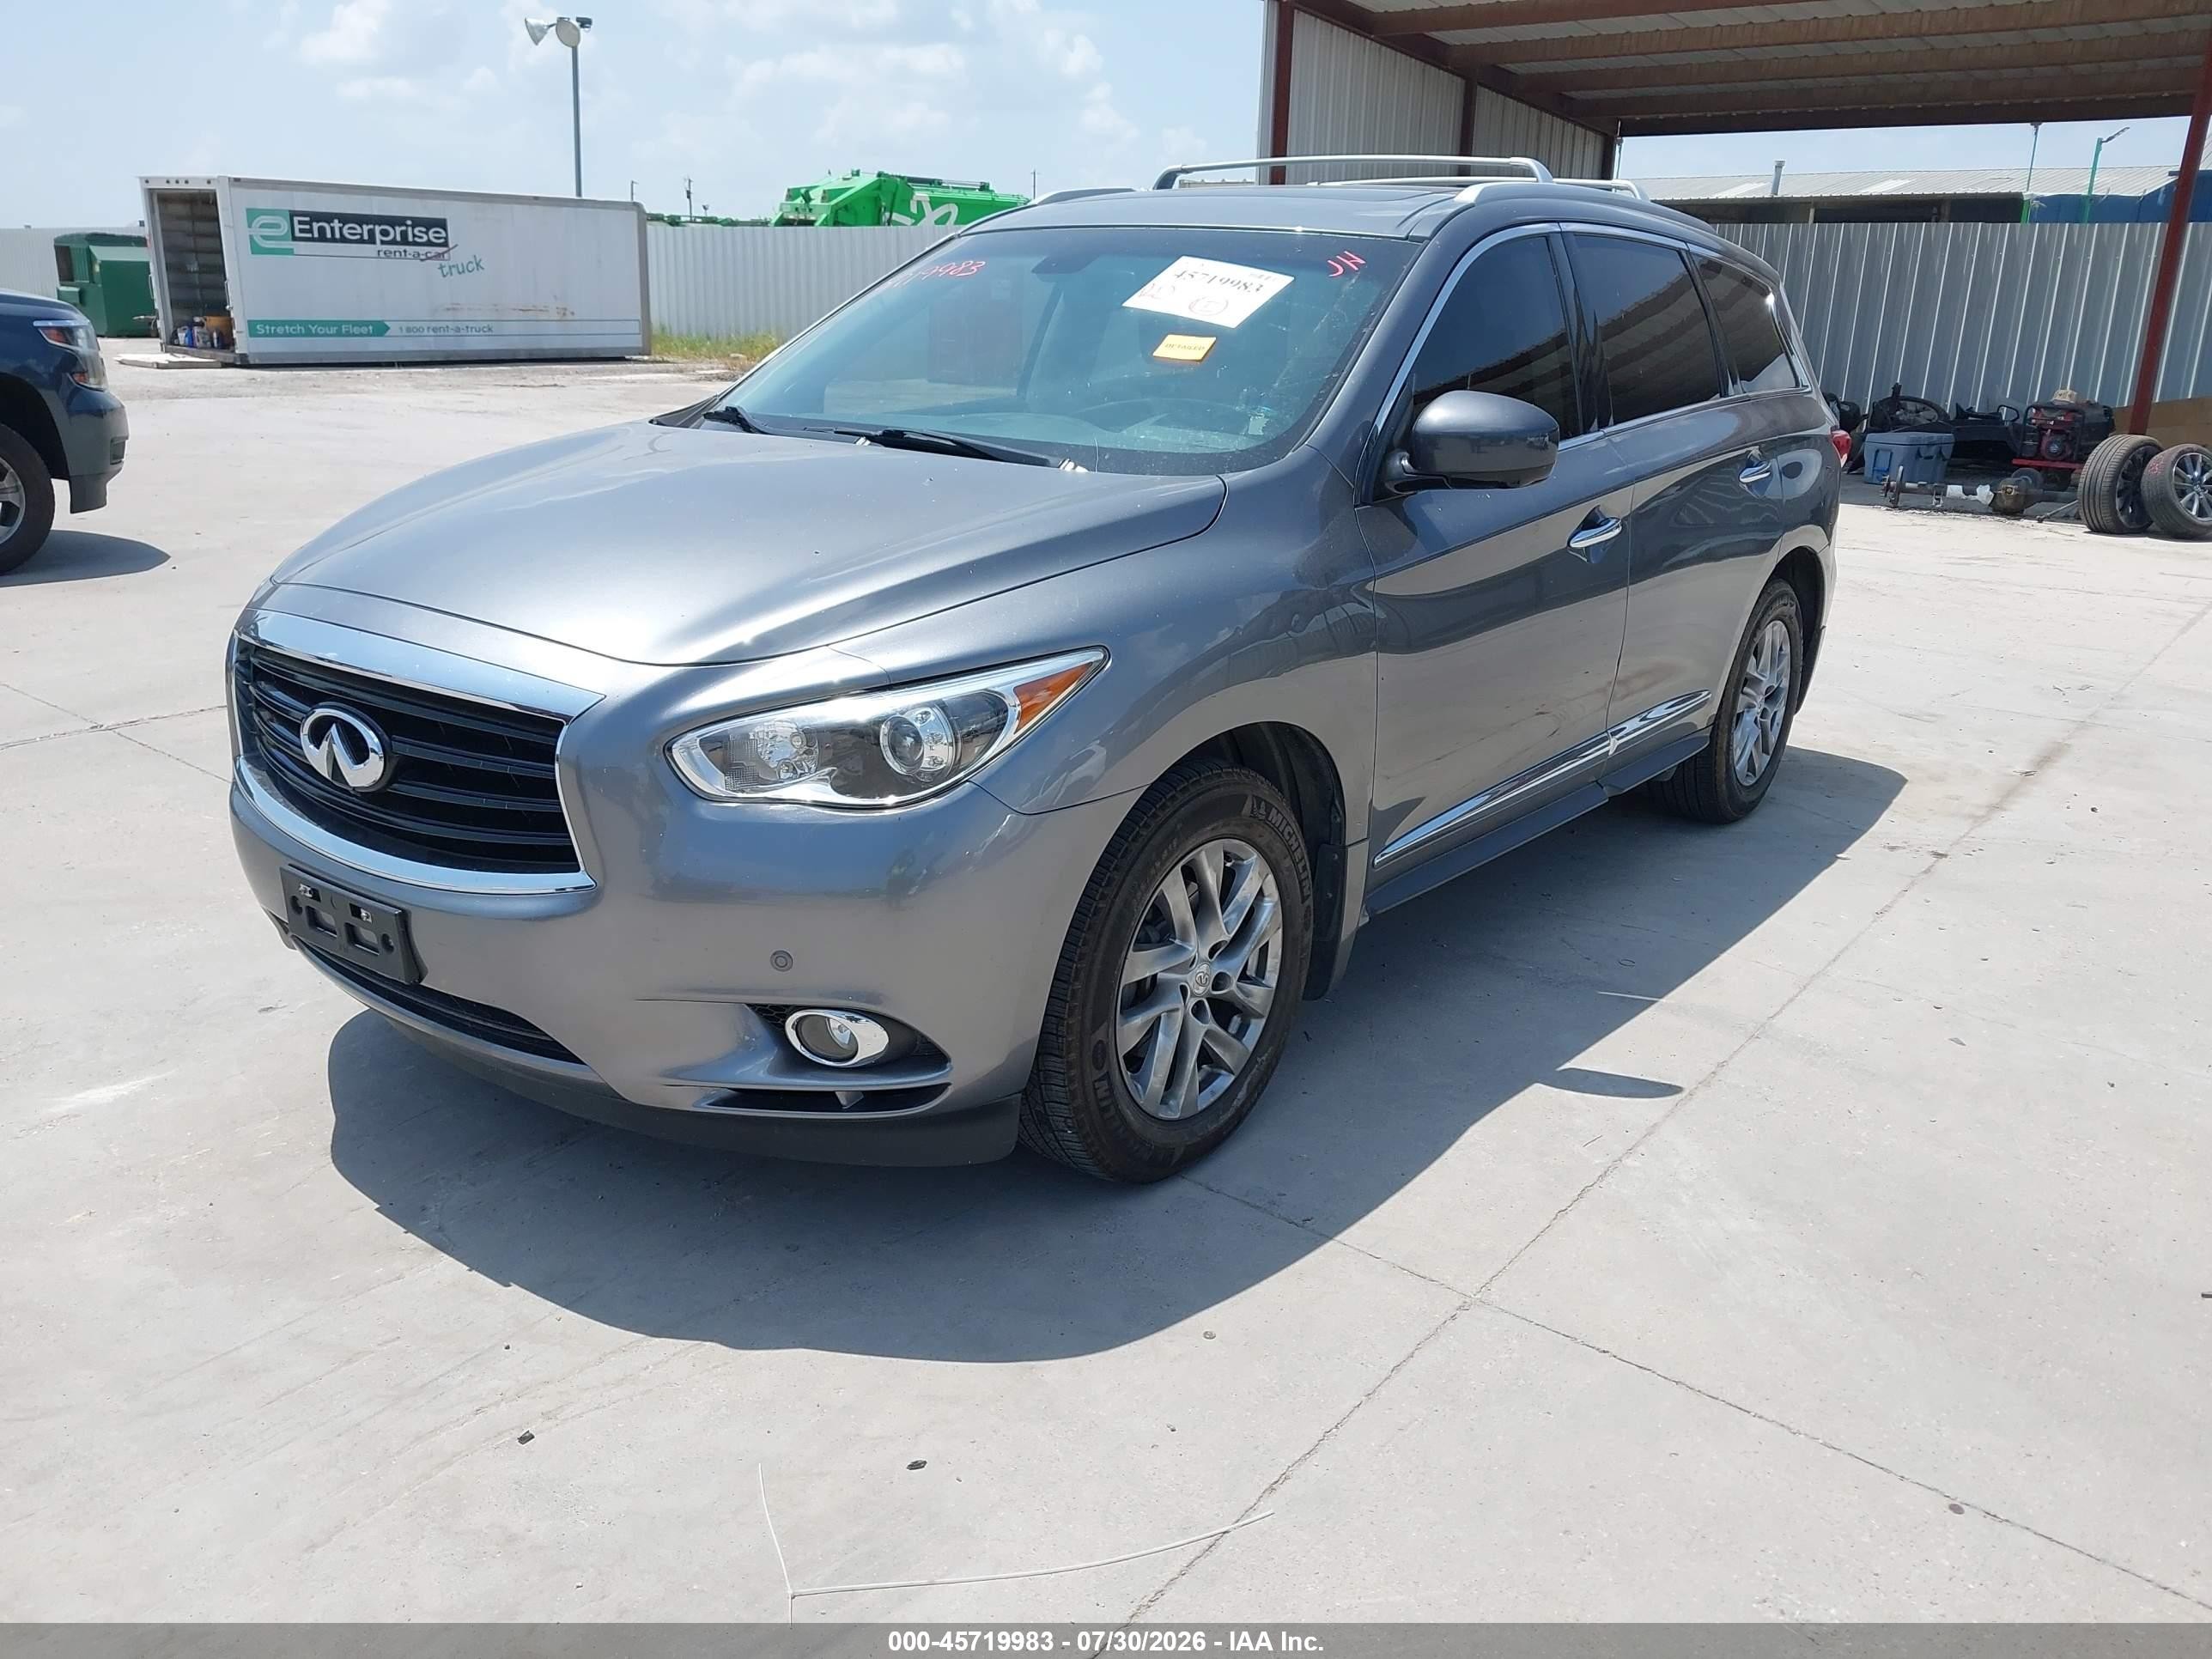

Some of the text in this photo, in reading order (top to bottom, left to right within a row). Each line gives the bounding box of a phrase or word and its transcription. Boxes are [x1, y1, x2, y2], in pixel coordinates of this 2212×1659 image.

[293, 216, 447, 246] Enterprise
[437, 255, 485, 278] truck
[257, 324, 374, 335] Stretch Your Fleet
[426, 324, 494, 334] rent-a-truck
[1267, 806, 1311, 901] MICHELIN
